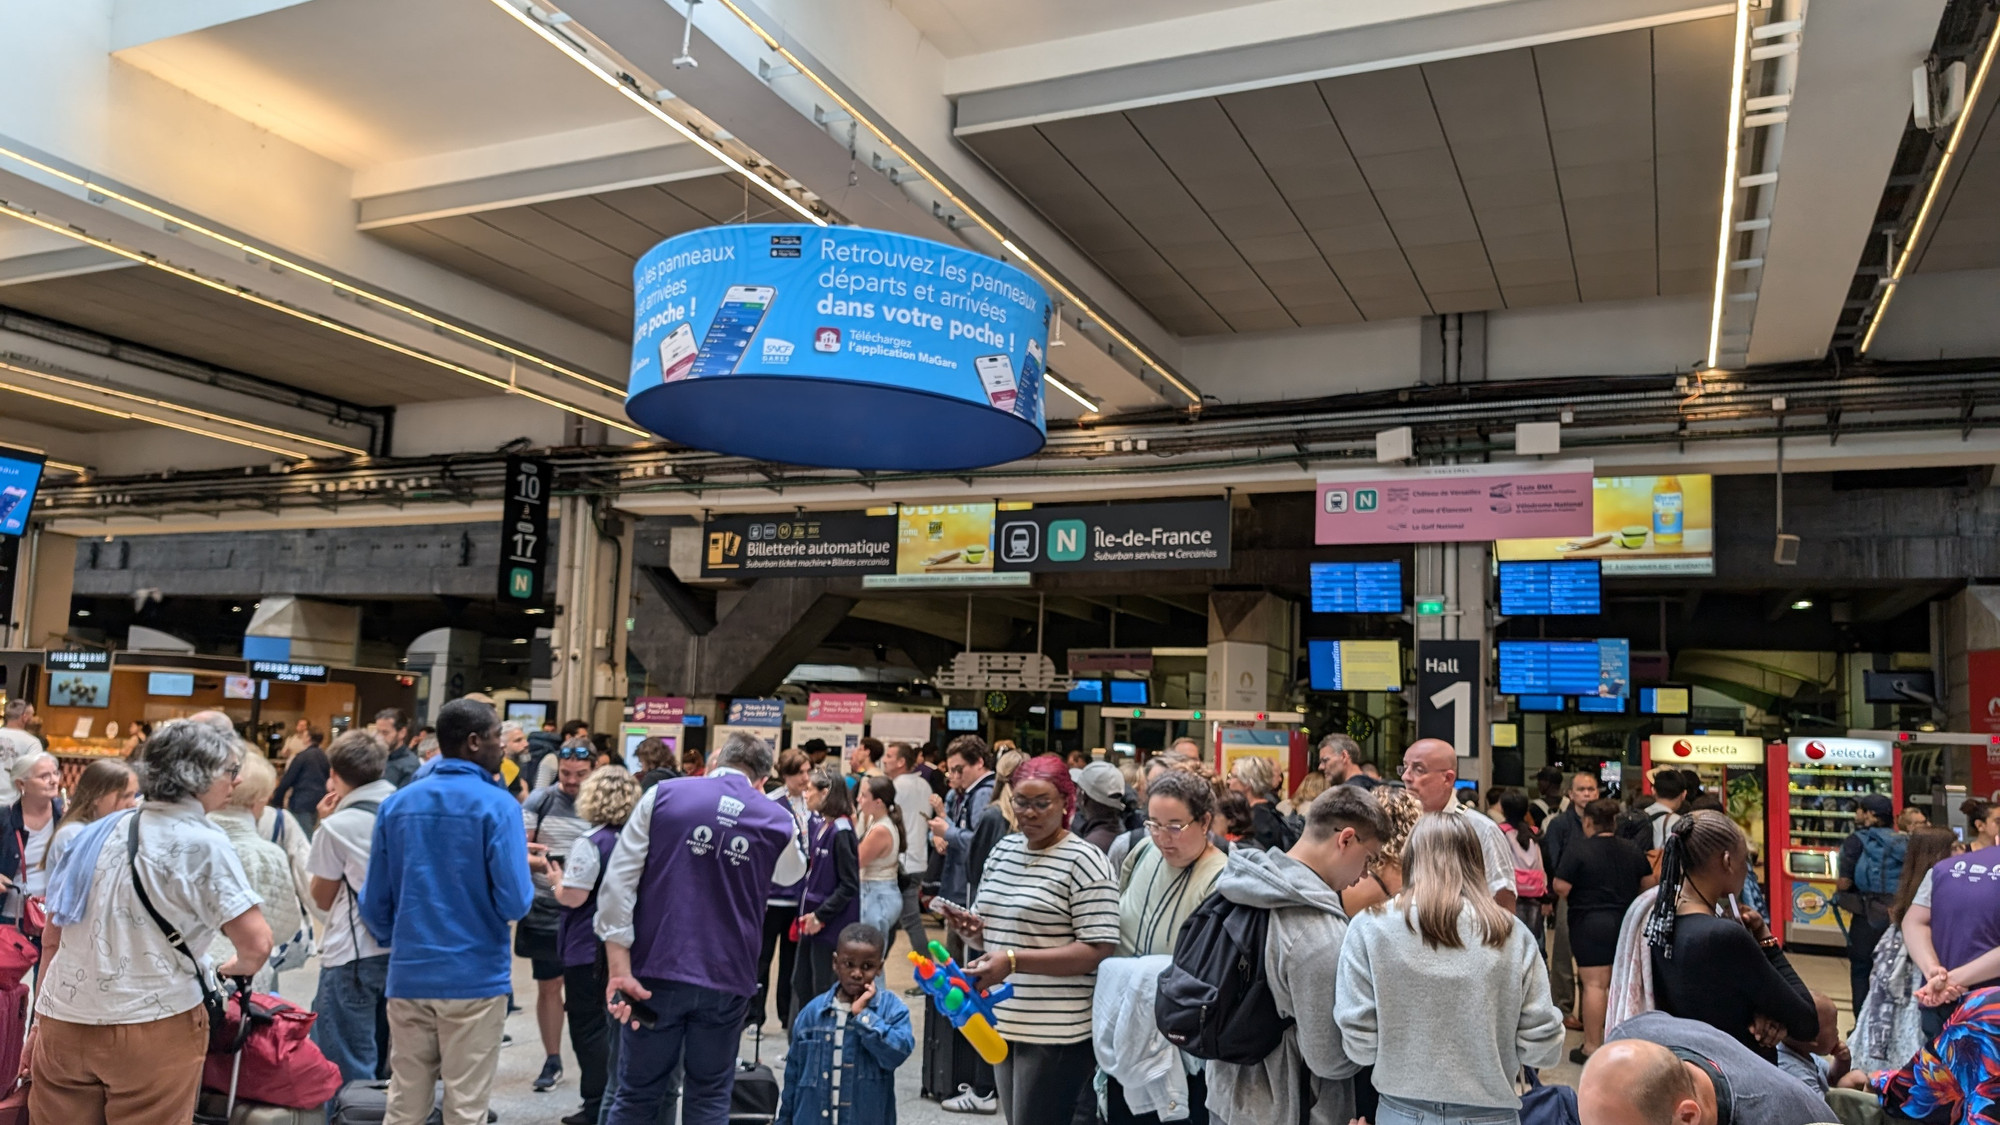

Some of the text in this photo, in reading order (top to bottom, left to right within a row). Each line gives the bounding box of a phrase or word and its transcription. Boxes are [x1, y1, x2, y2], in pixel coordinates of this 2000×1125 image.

[658, 246, 735, 281] panneaux
[821, 238, 1037, 313] Retrouvez les panneaux
[646, 278, 687, 310] arrivées
[818, 266, 1006, 323] départs et arrivées
[648, 302, 685, 338] poche
[690, 296, 697, 317] !
[816, 293, 1015, 353] dans votre poche !
[849, 330, 912, 349] Téléchargez
[917, 352, 958, 370] MaGare
[516, 474, 540, 499] 10
[1360, 492, 1373, 508] N
[512, 533, 537, 558] 17
[747, 539, 891, 557] Billetterie automatique
[1056, 529, 1077, 552] N
[1093, 525, 1212, 548] Île-de-France
[746, 559, 778, 569] Suburban
[778, 559, 797, 568] ticket
[798, 558, 827, 568] machine
[1094, 551, 1134, 561] Suburban
[1134, 550, 1168, 560] services
[514, 574, 528, 592] N
[1425, 658, 1459, 673] Hall
[1429, 681, 1471, 756] 1
[1695, 744, 1737, 754] selecta
[1830, 747, 1876, 759] selecta
